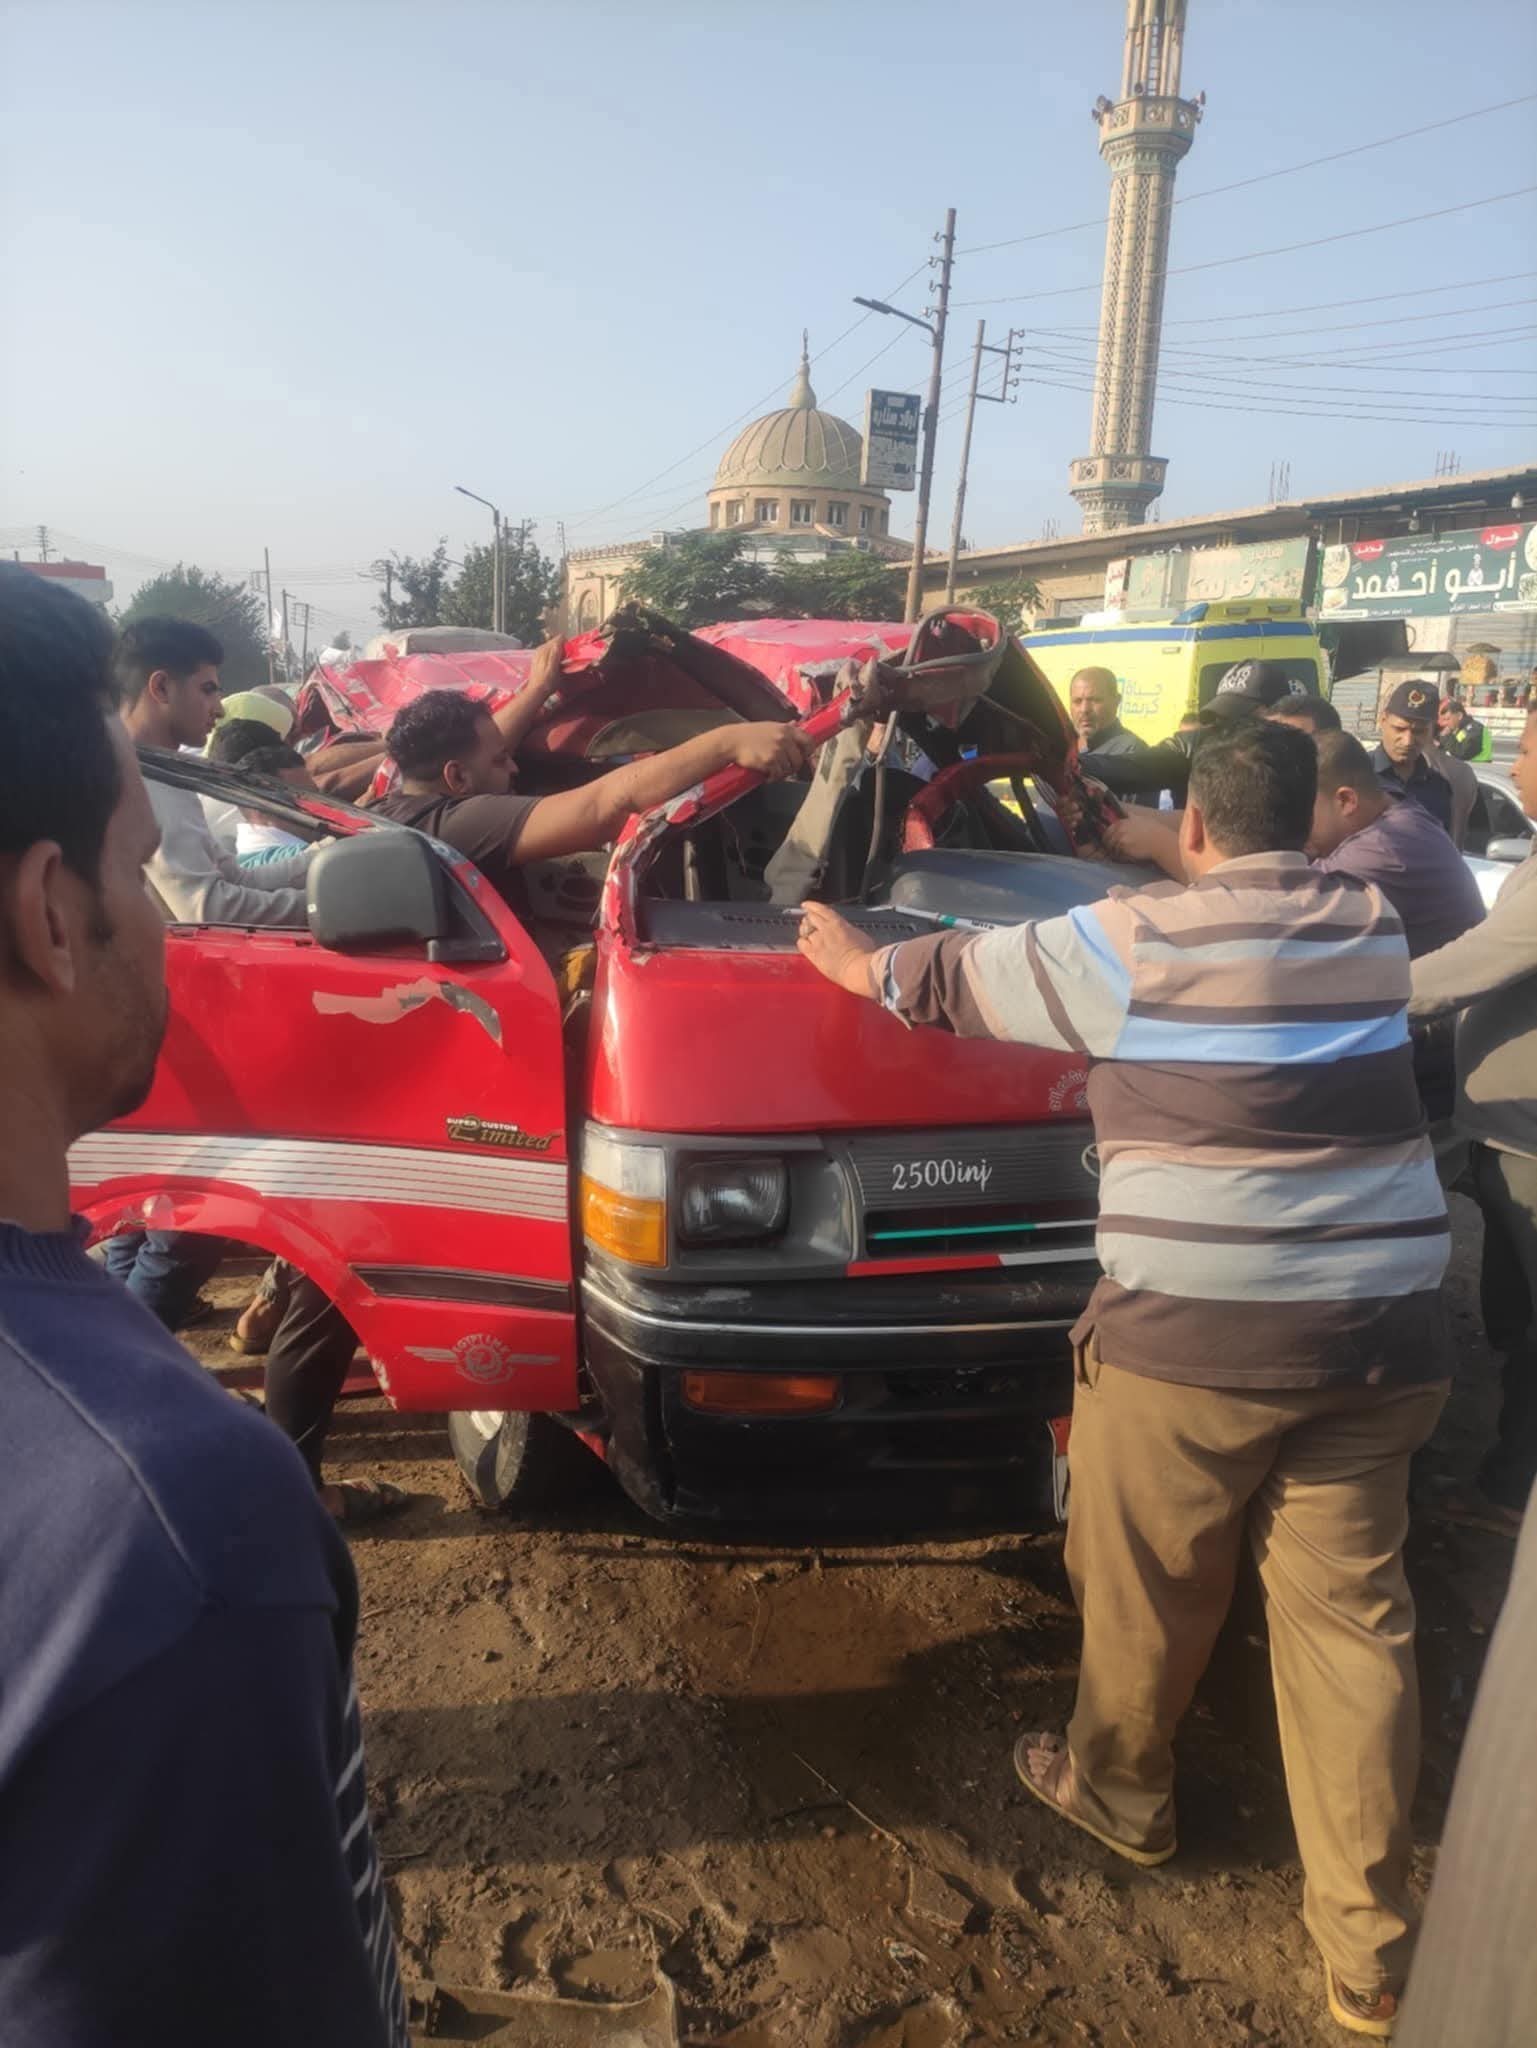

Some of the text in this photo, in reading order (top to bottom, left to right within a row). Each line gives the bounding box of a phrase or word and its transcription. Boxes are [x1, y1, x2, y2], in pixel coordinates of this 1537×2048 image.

[1351, 551, 1516, 602] أبو أحمد
[446, 1117, 518, 1132] SUPER CUSTOM
[448, 1124, 562, 1150] Limited
[892, 1158, 992, 1192] 2500inj
